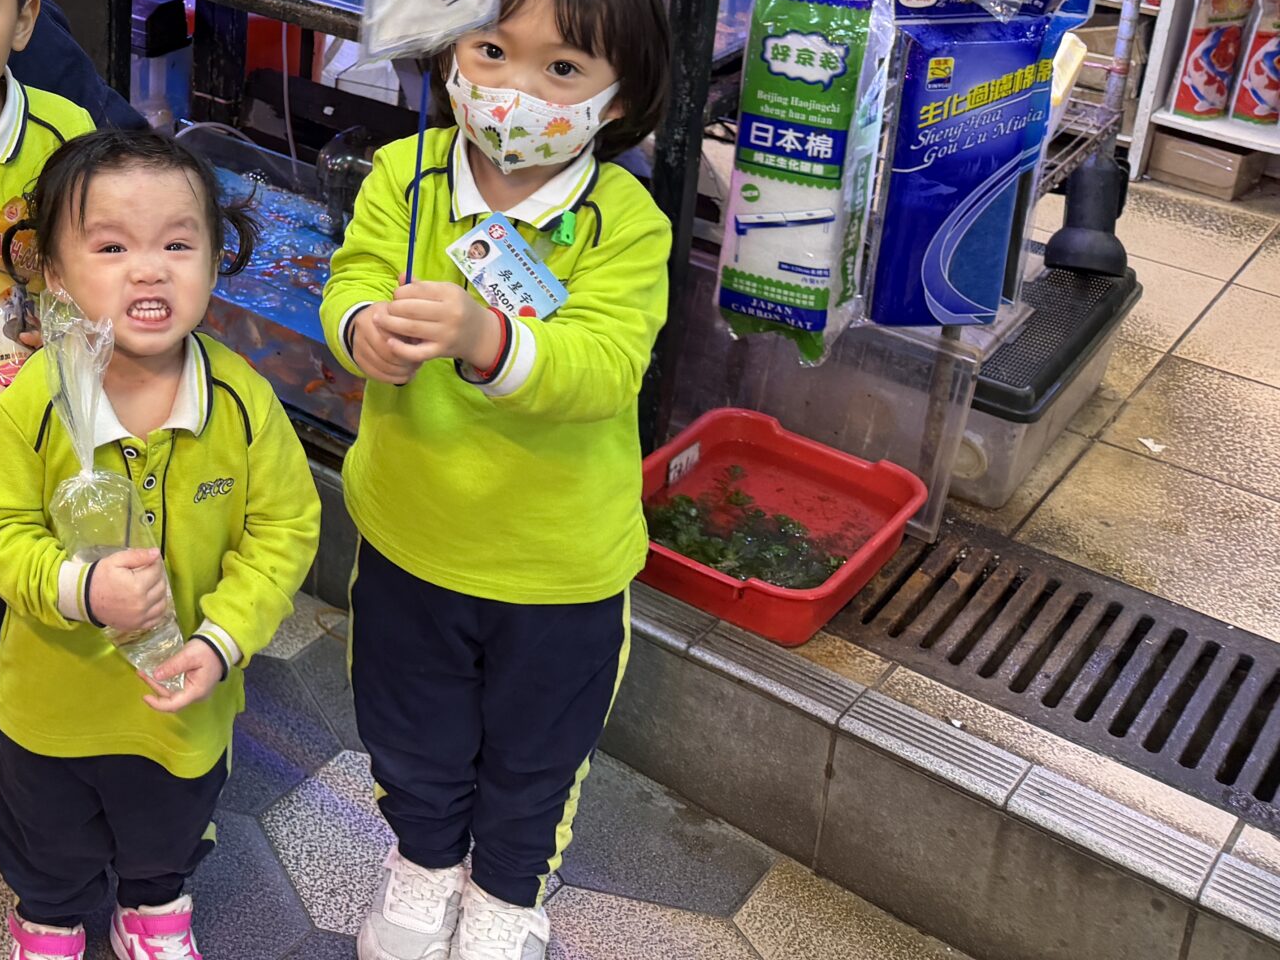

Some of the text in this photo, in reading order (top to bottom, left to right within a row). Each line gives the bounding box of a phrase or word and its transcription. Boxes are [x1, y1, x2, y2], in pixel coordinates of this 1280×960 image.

[757, 90, 789, 105] Beijing
[760, 104, 833, 125] sheng hua mian
[750, 121, 833, 159] 日本棉
[923, 141, 958, 163] Gou
[962, 132, 988, 150] Lu
[488, 283, 515, 312] Aston
[751, 298, 792, 315] JAPAN
[731, 303, 813, 330] CARBON MAT
